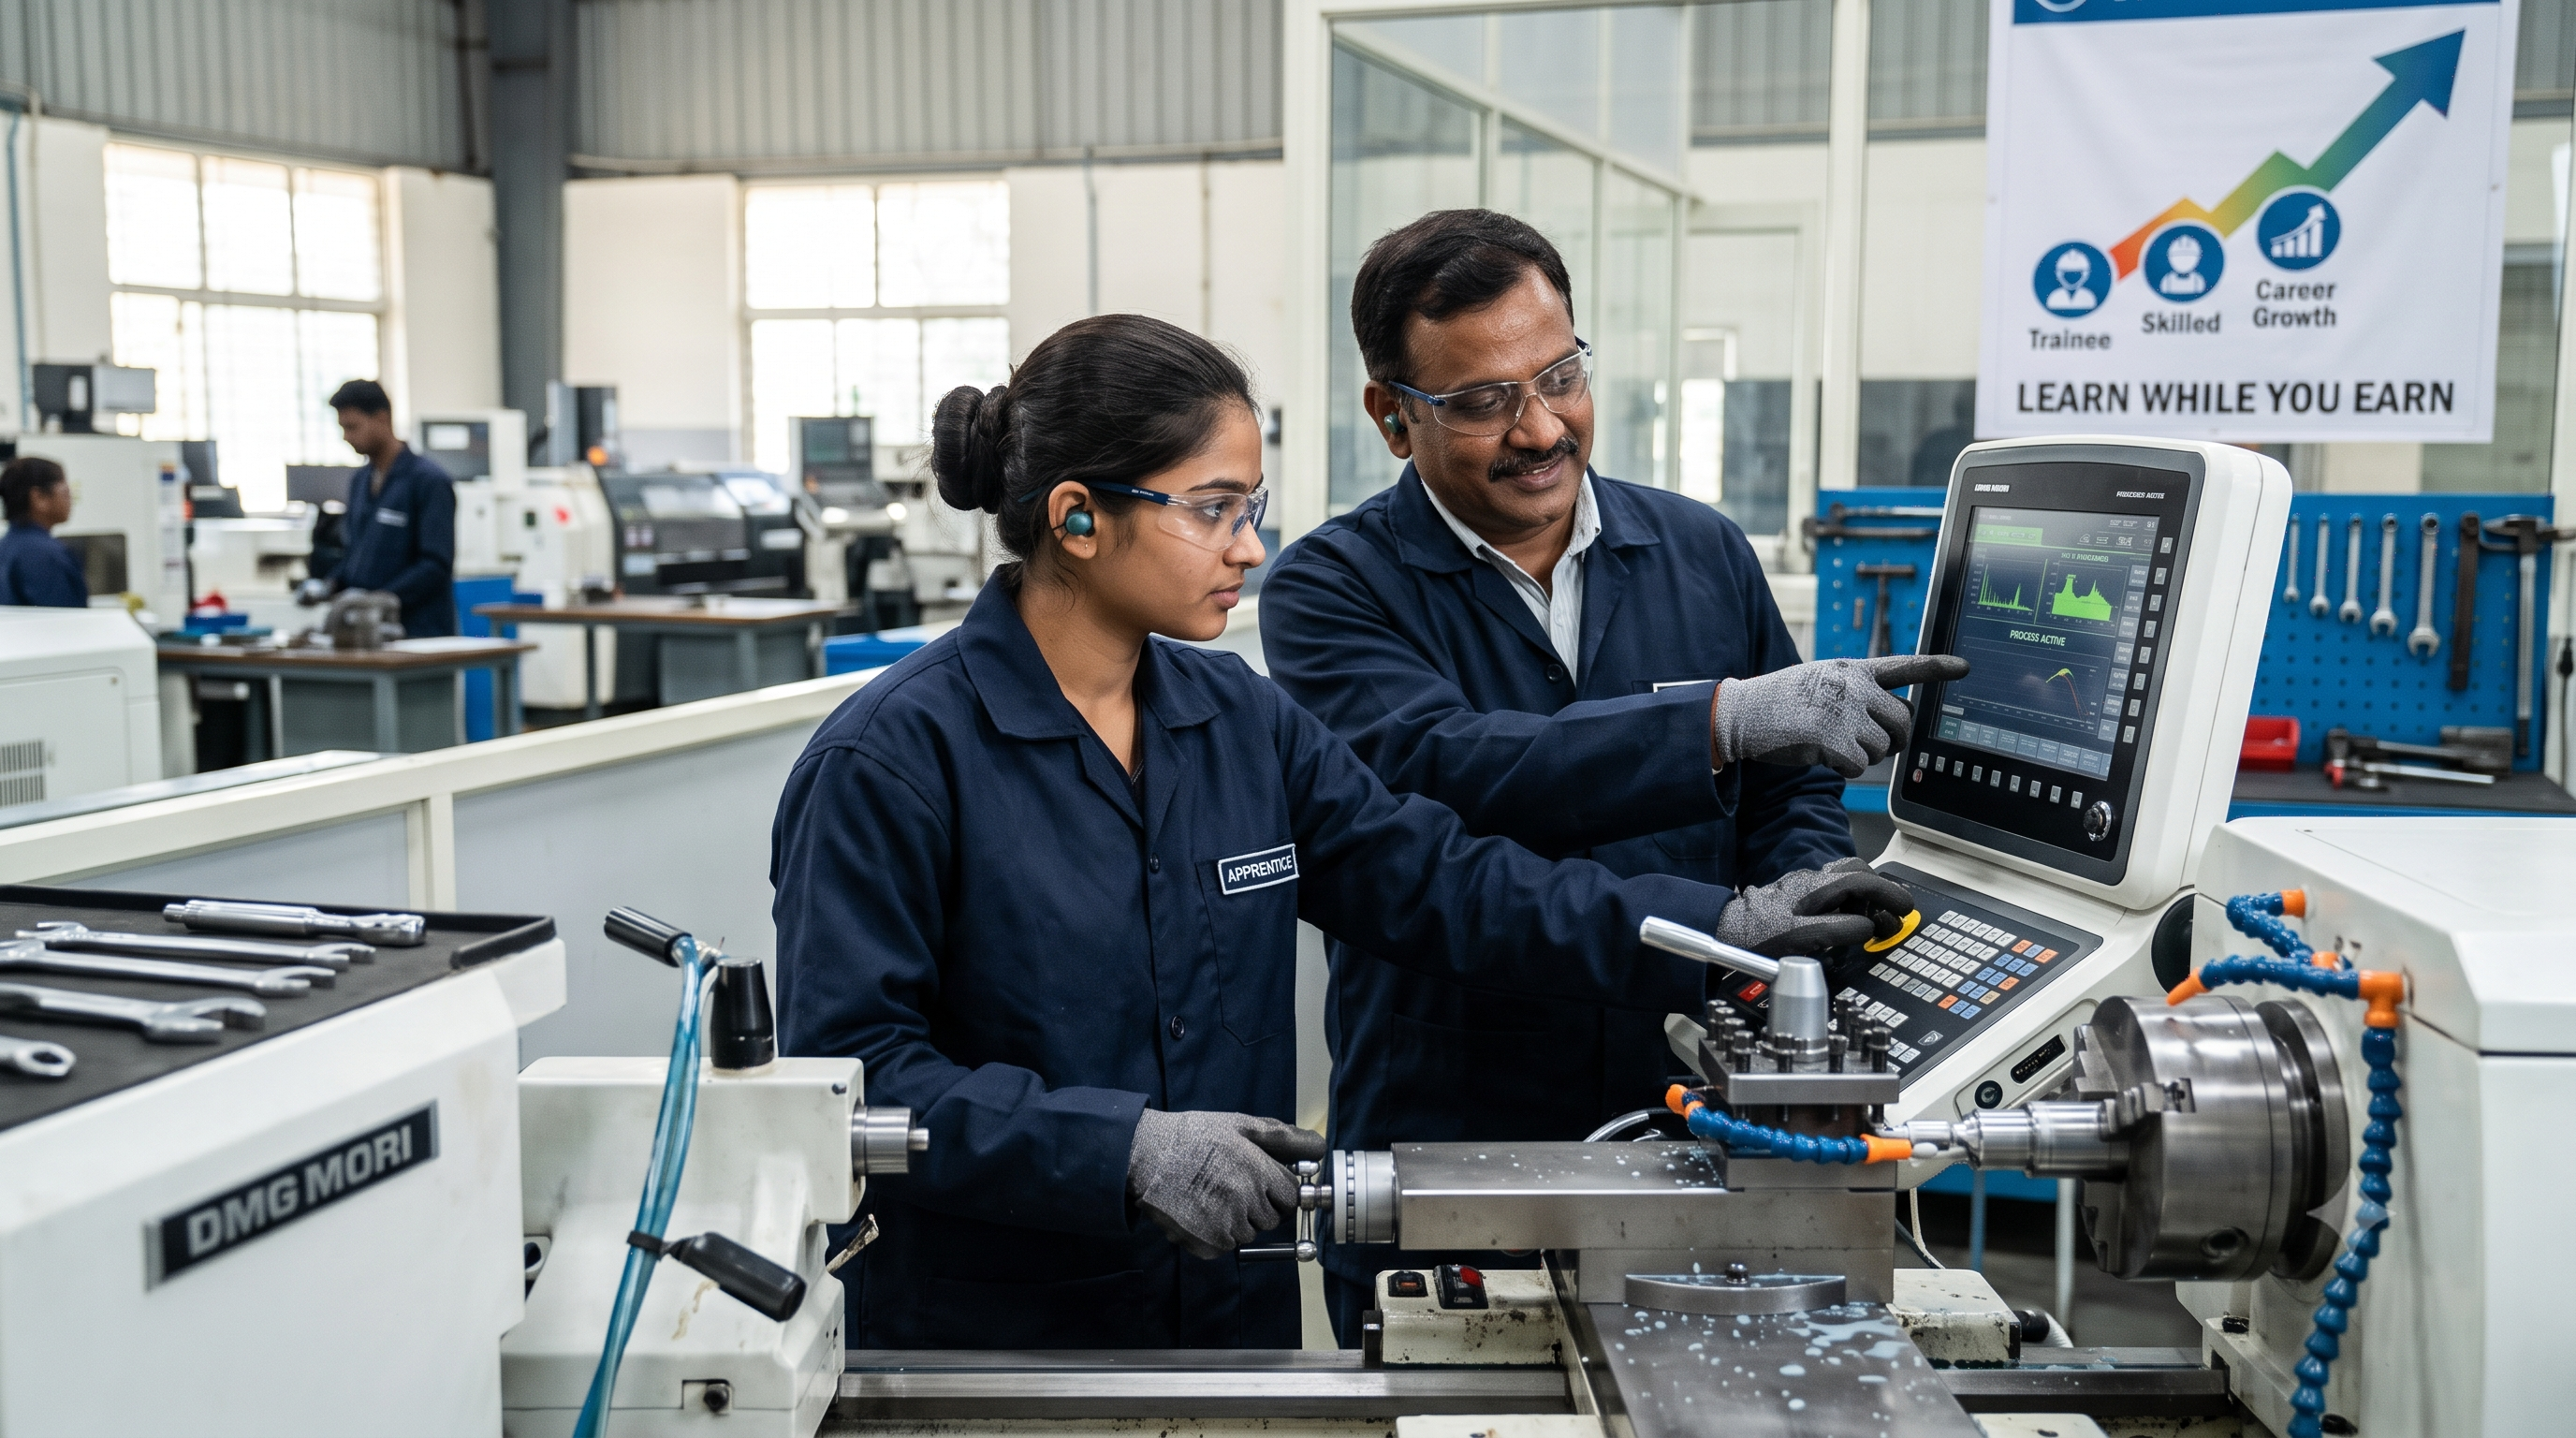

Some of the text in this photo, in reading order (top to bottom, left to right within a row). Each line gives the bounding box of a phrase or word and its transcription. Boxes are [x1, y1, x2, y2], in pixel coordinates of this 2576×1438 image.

[2256, 280, 2336, 301] Career
[2142, 312, 2221, 333] Skilled
[2252, 306, 2336, 328] Growth
[2029, 329, 2111, 349] Trainee
[2017, 382, 2454, 414] LEARN WHILE YOU EARN
[2010, 629, 2040, 642] PROCESS
[1227, 855, 1293, 883] APPRENTICE
[187, 1124, 413, 1257] DMG MORI
